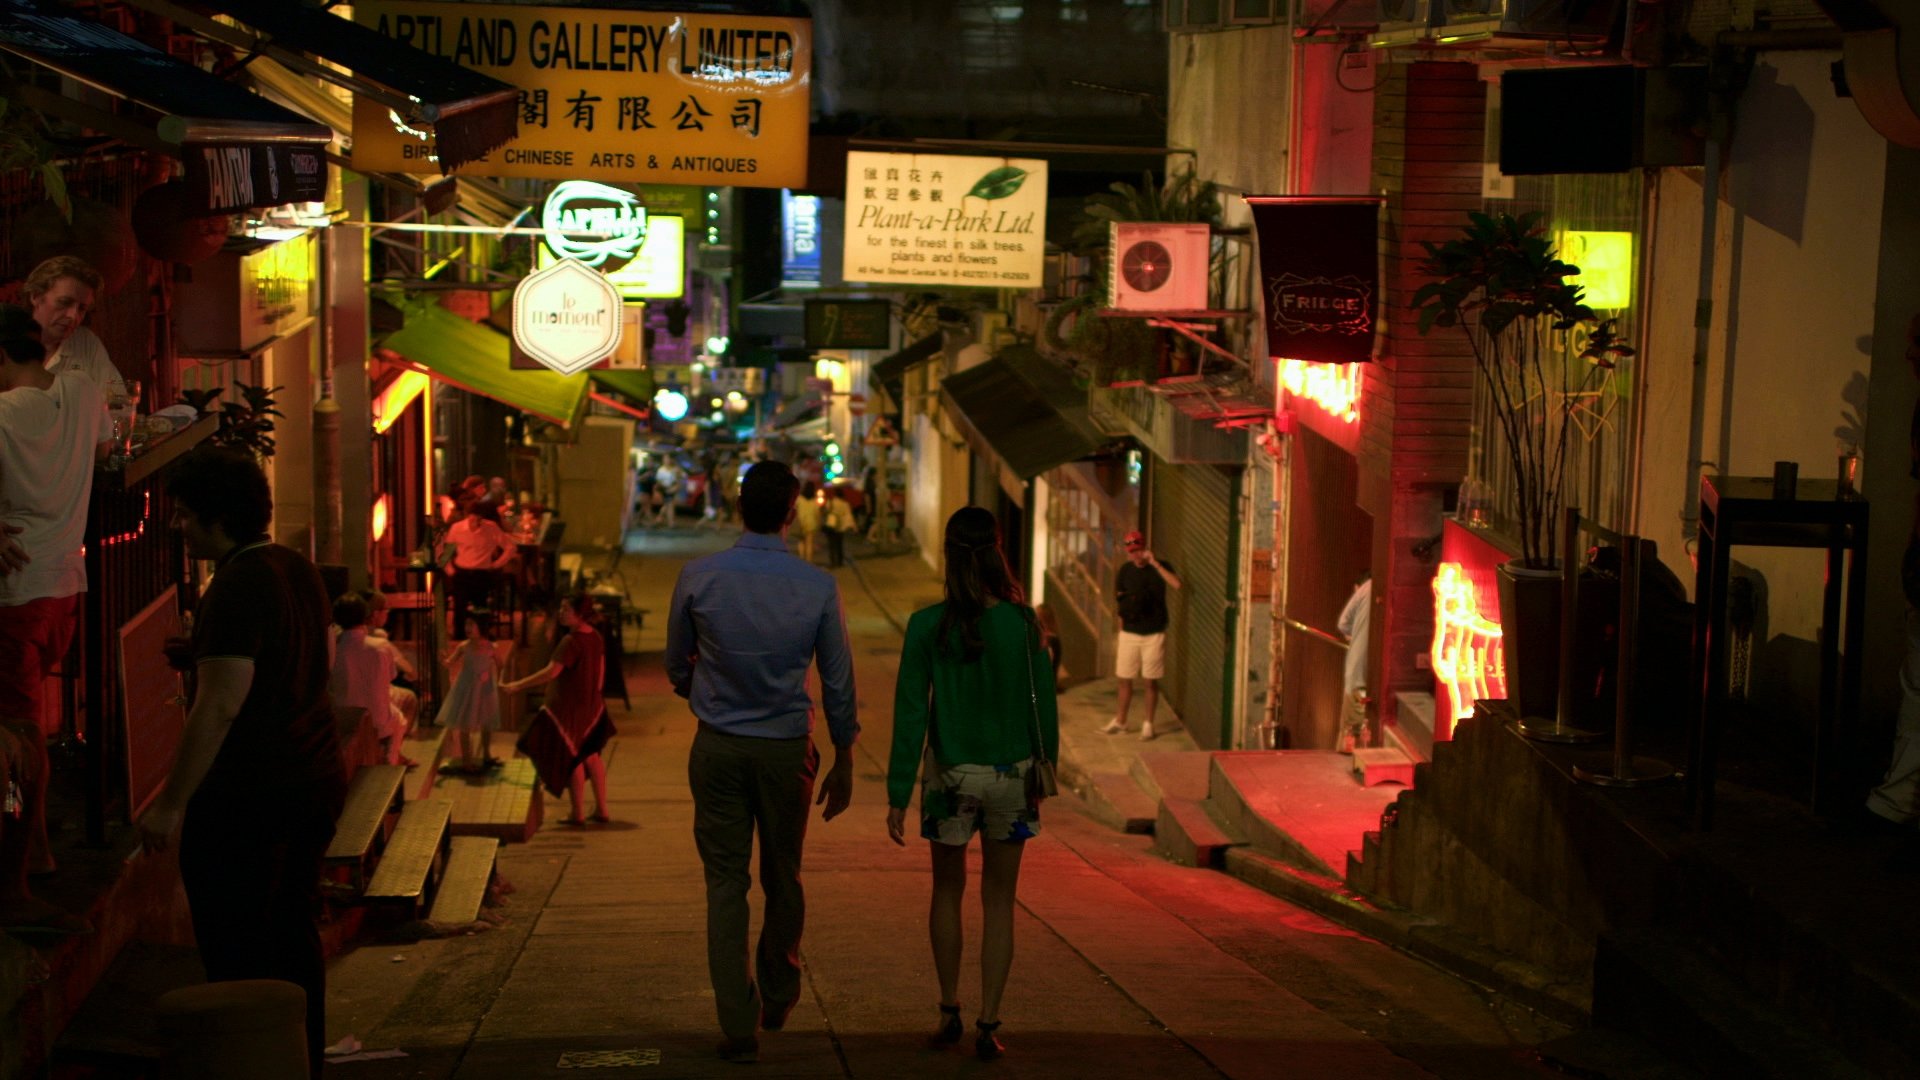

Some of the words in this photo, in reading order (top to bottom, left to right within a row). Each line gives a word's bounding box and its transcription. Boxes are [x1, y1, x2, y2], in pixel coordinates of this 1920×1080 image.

[529, 19, 667, 74] GALLERY
[680, 25, 794, 80] LIMITED
[504, 148, 573, 167] CHINESE
[591, 151, 635, 168] ARTS
[648, 154, 659, 169] &
[671, 156, 757, 173] ANTIQUES
[857, 205, 992, 233] Plant-a-Park
[993, 210, 1034, 234] Ltd.
[867, 235, 883, 247] for
[890, 235, 908, 248] the
[915, 235, 947, 249] finest
[954, 237, 964, 250] in
[970, 237, 988, 250] silk
[891, 250, 925, 263] plants
[932, 252, 953, 264] and
[958, 253, 998, 265] flowers
[1282, 293, 1361, 310] FRIDGE
[532, 308, 606, 326] moment
